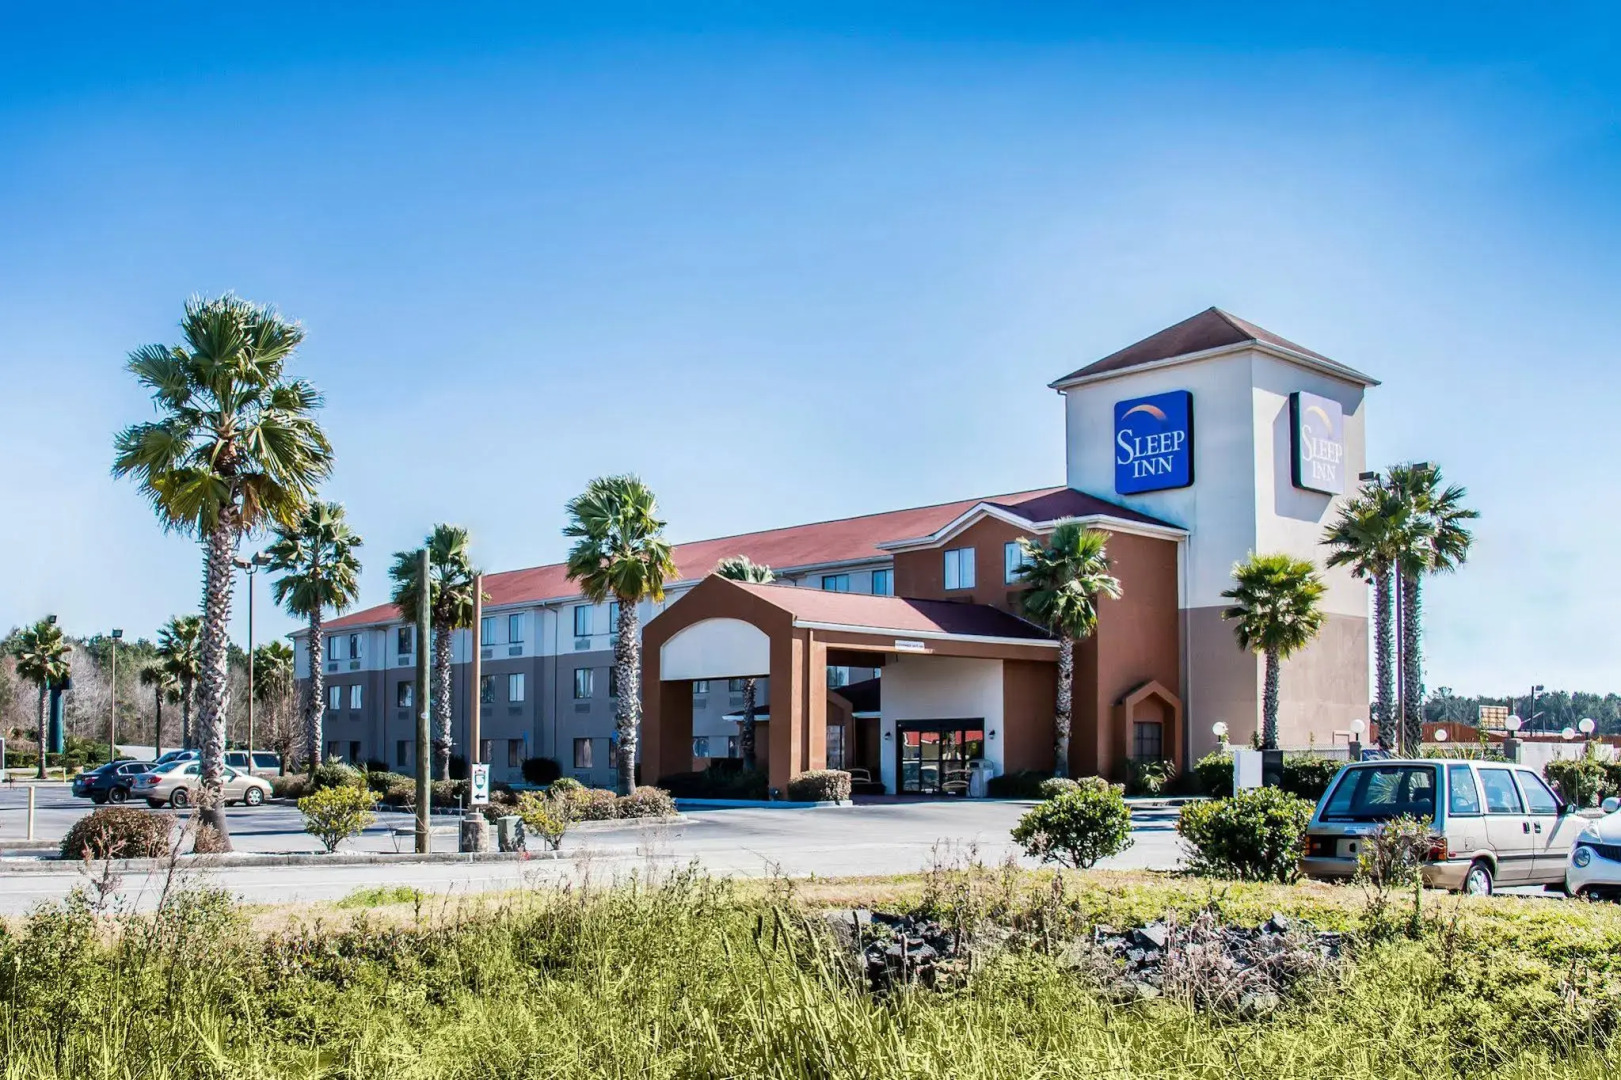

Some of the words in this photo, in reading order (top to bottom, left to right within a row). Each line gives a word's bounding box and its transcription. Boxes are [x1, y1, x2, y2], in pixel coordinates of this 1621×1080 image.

[1117, 429, 1185, 465] SLEEP
[1302, 424, 1343, 464] SLEEP
[1132, 455, 1174, 478] INN
[1312, 460, 1336, 481] INN
